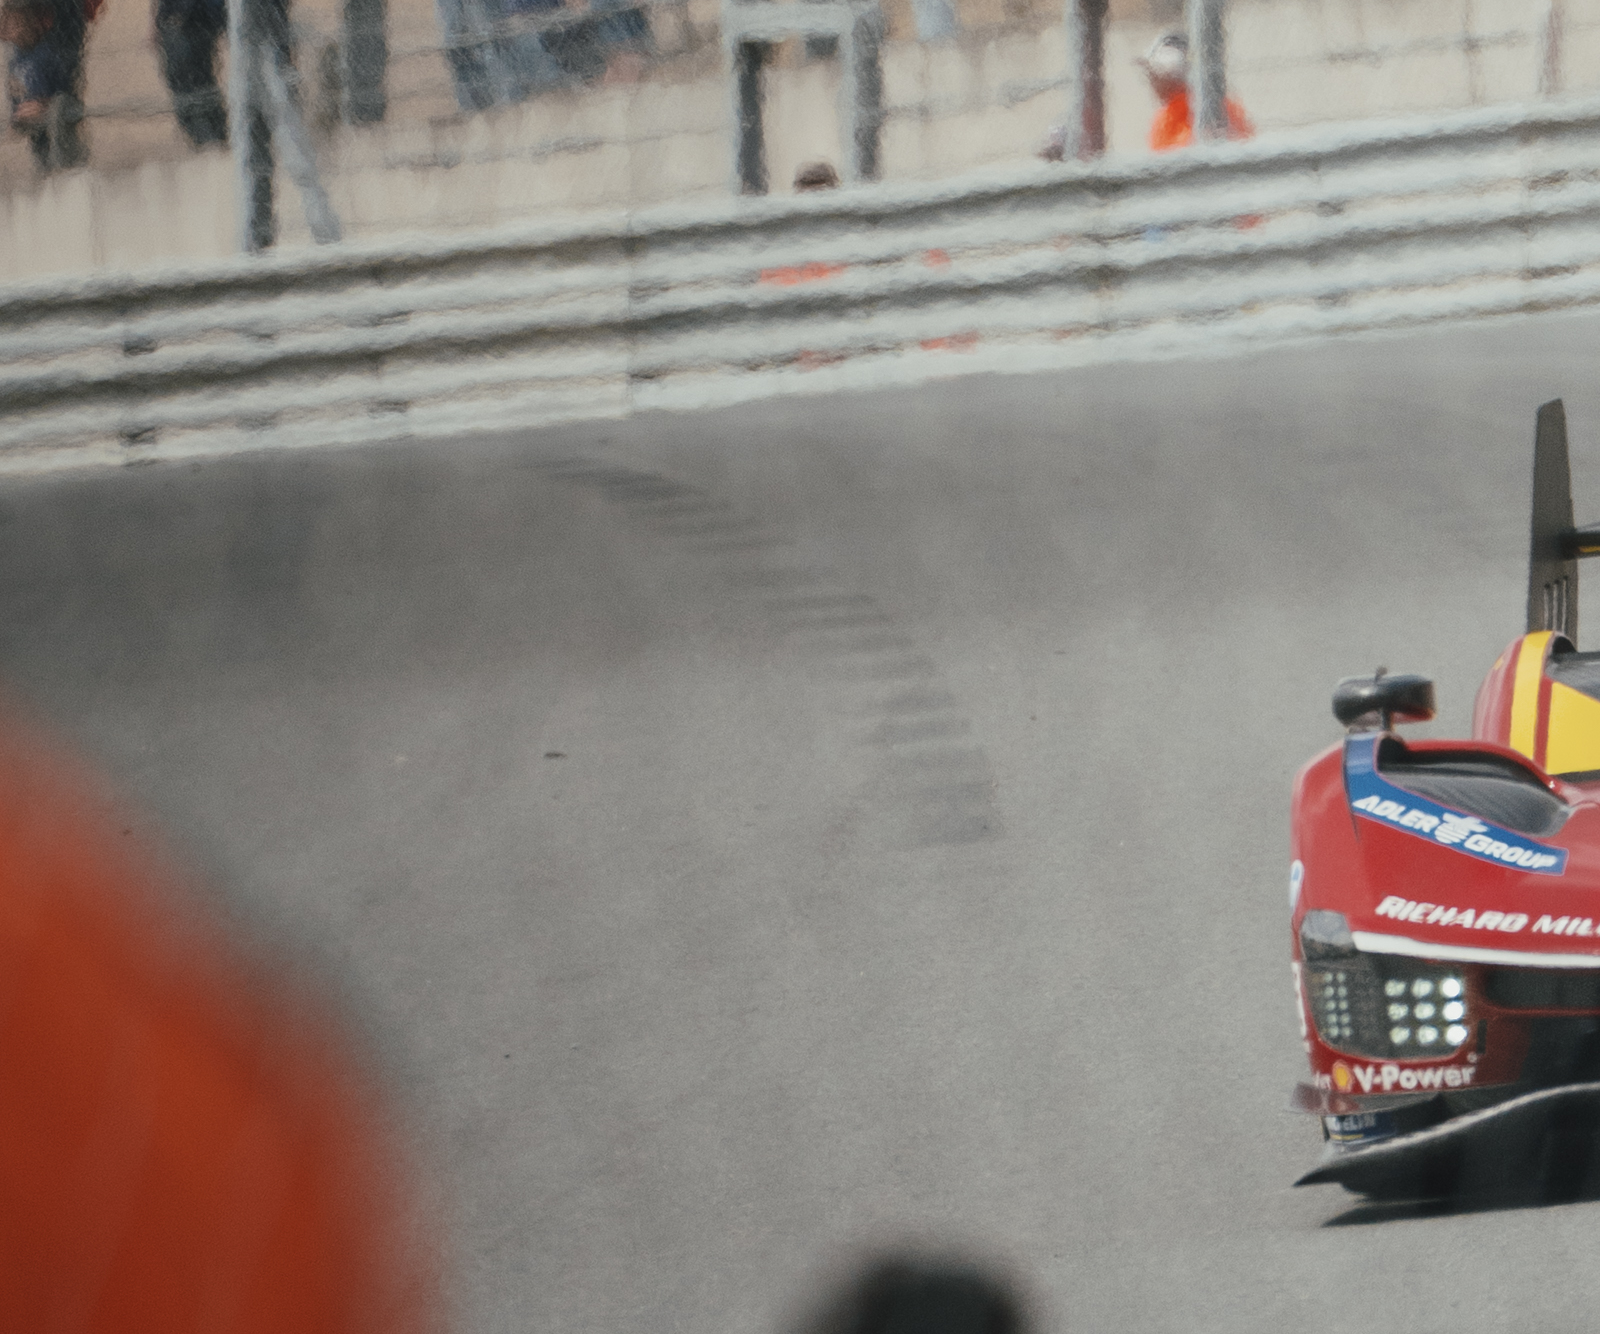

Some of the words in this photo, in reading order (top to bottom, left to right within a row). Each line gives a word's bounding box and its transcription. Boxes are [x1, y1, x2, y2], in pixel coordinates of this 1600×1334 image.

[1352, 795, 1440, 833] ADLER
[1463, 834, 1558, 868] GROUP
[1375, 895, 1529, 933] RICHARD
[1353, 1063, 1476, 1093] V-Power
